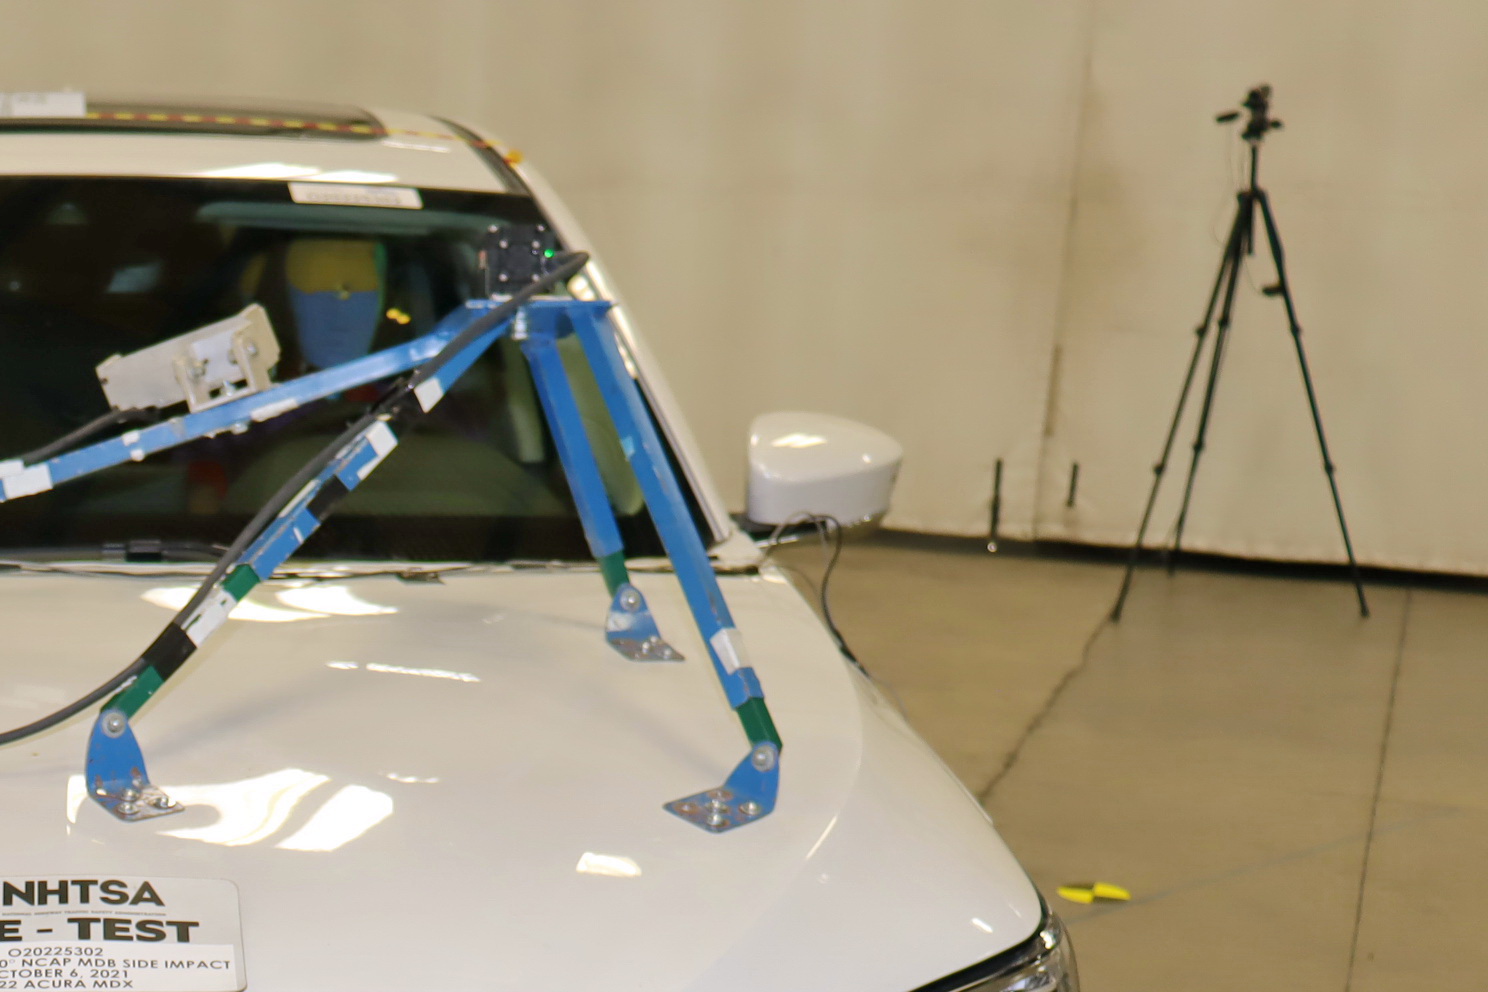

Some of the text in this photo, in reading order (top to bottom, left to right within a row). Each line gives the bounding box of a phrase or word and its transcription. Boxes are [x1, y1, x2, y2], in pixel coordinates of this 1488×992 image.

[2, 879, 166, 907] NHTSA
[67, 917, 200, 943] TEST
[21, 957, 72, 968] NCAP
[77, 957, 117, 968] MDB
[122, 958, 159, 969] SIDE
[164, 959, 231, 970] IMPACT
[69, 968, 84, 980] 6,
[90, 968, 129, 979] 2021
[23, 979, 87, 989] ACURA
[92, 979, 134, 989] MDX
